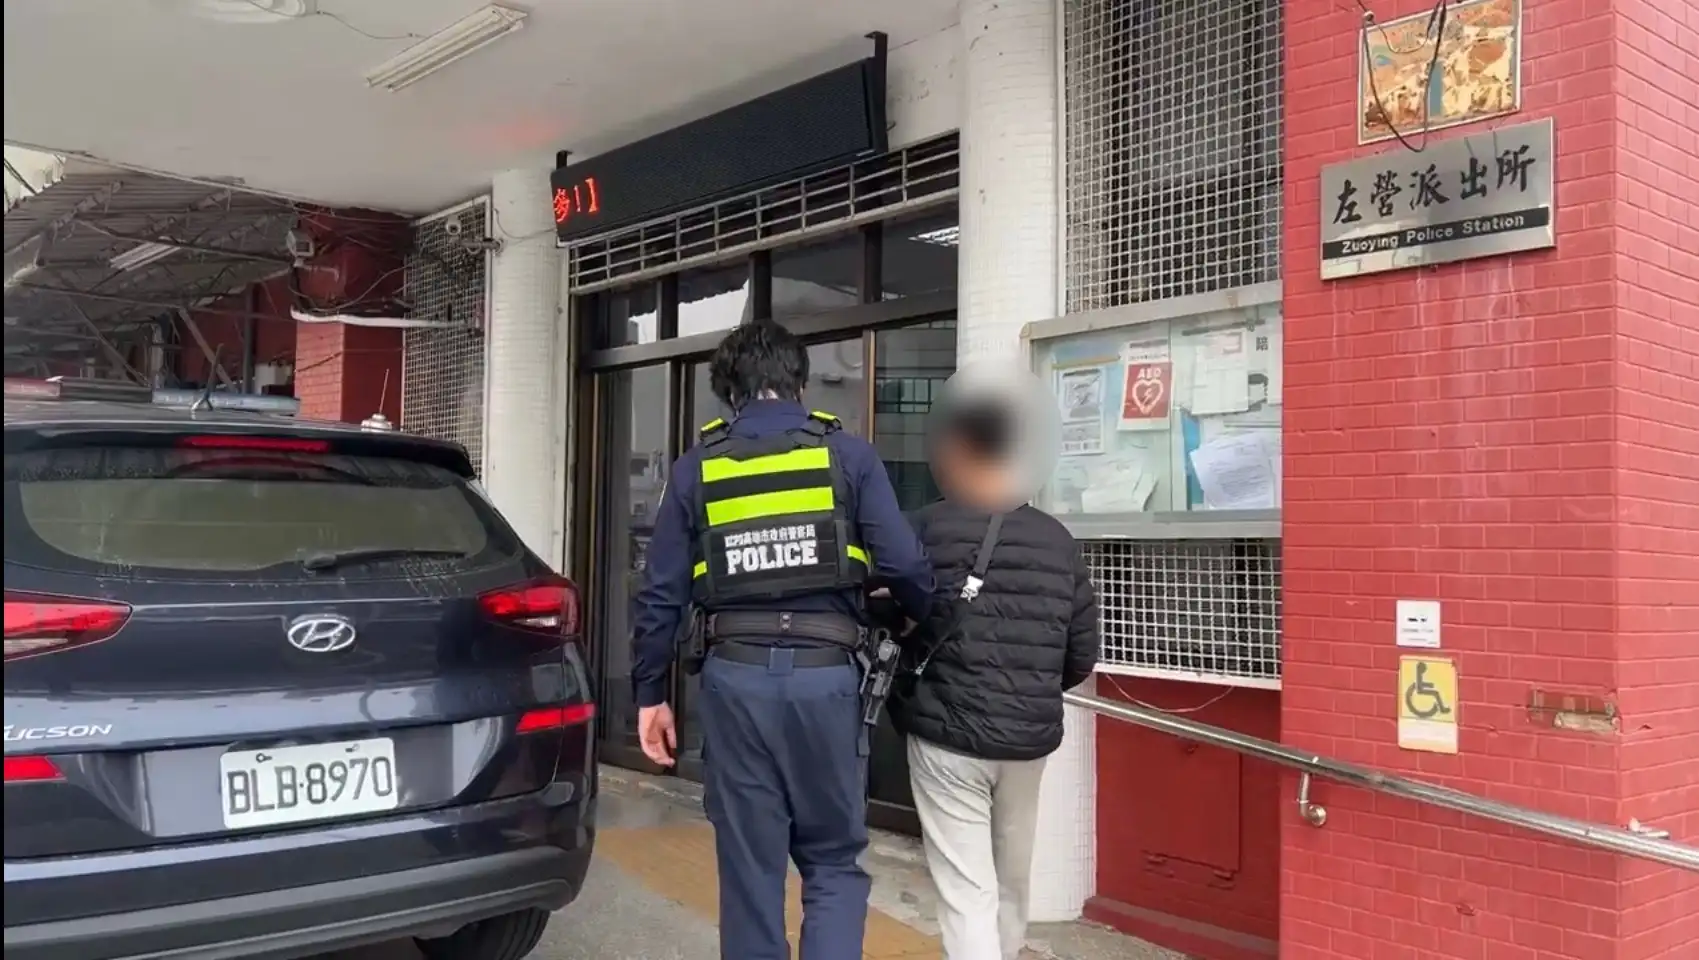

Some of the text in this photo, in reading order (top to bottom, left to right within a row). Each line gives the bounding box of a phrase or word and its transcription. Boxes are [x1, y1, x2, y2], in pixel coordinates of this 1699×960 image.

[1333, 144, 1535, 224] 左營派出所
[1342, 214, 1525, 253] Zuoying Police Station
[1137, 367, 1162, 379] AED
[725, 539, 818, 575] POLICE
